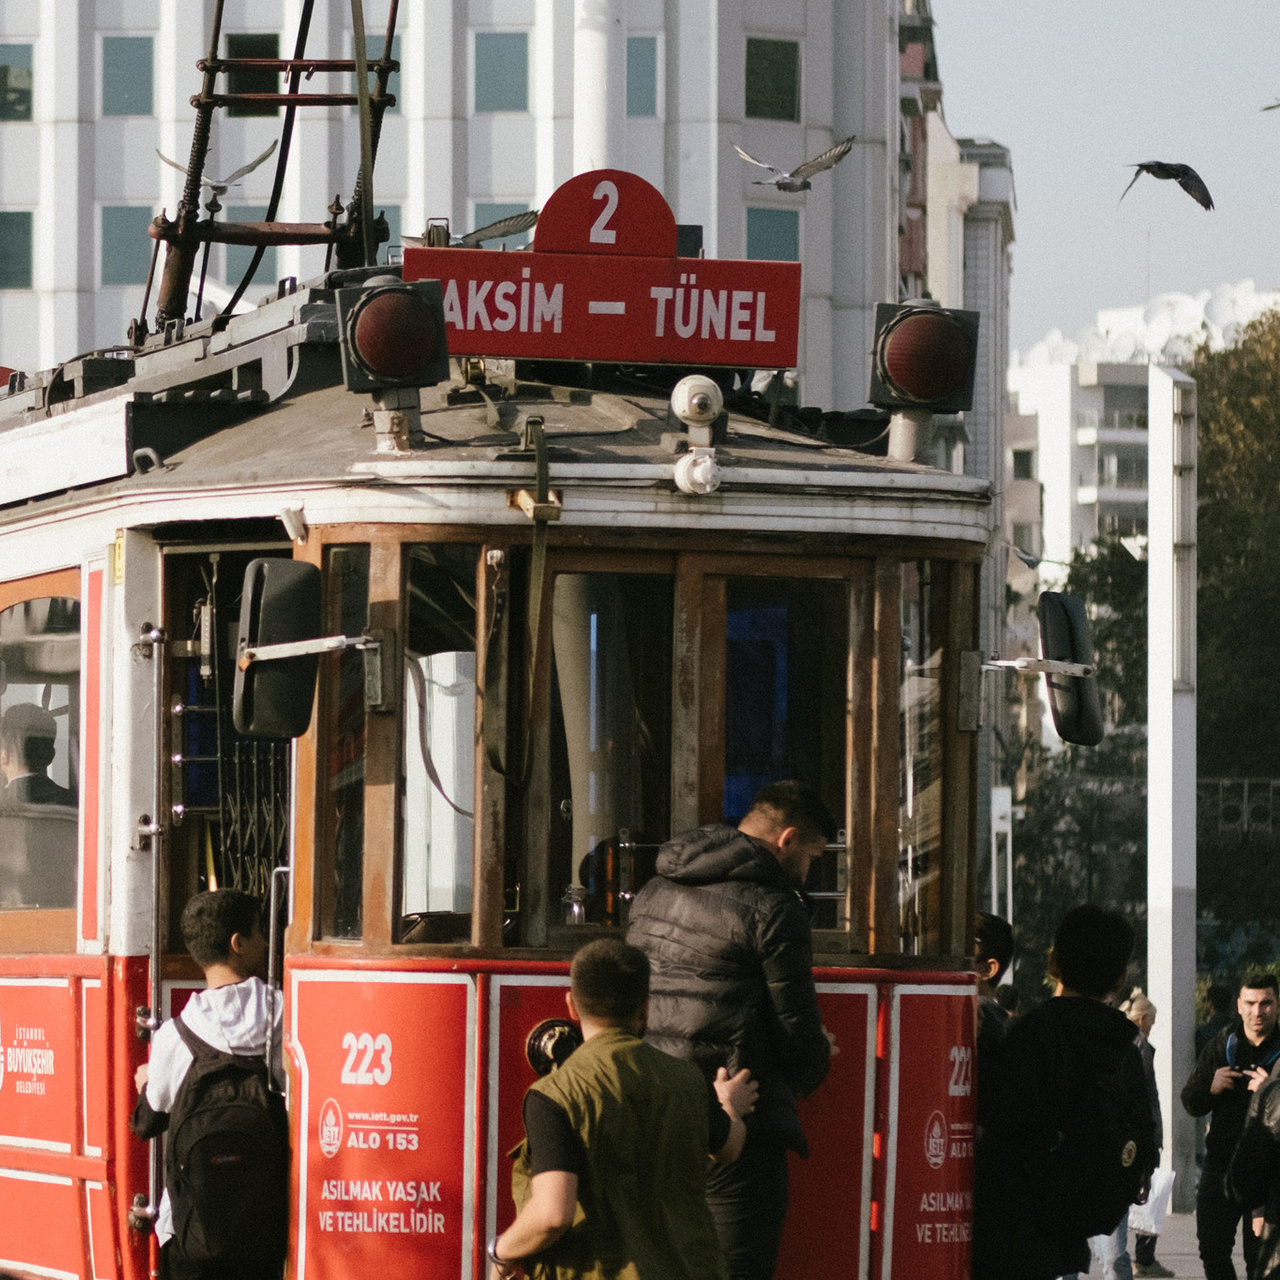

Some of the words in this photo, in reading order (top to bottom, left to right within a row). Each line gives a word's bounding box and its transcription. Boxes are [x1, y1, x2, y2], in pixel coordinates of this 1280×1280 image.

[589, 180, 620, 245] 2
[419, 266, 565, 334] AKSİM
[650, 273, 777, 343] TÜNEL
[15, 1024, 46, 1041] İSTANBUL
[7, 1040, 55, 1081] BÜYÜKŞEHİR
[340, 1031, 393, 1086] 223
[16, 1079, 46, 1095] BELEDİYESİ
[347, 1111, 419, 1124] www.iett.gov.tr
[346, 1131, 381, 1150] ALO
[385, 1132, 419, 1151] 153
[321, 1180, 383, 1202] ASILMAK
[386, 1181, 442, 1202] YASAK
[318, 1211, 334, 1232] VE
[336, 1208, 446, 1234] TEHLİKELİDİR
[916, 1223, 933, 1243] VE
